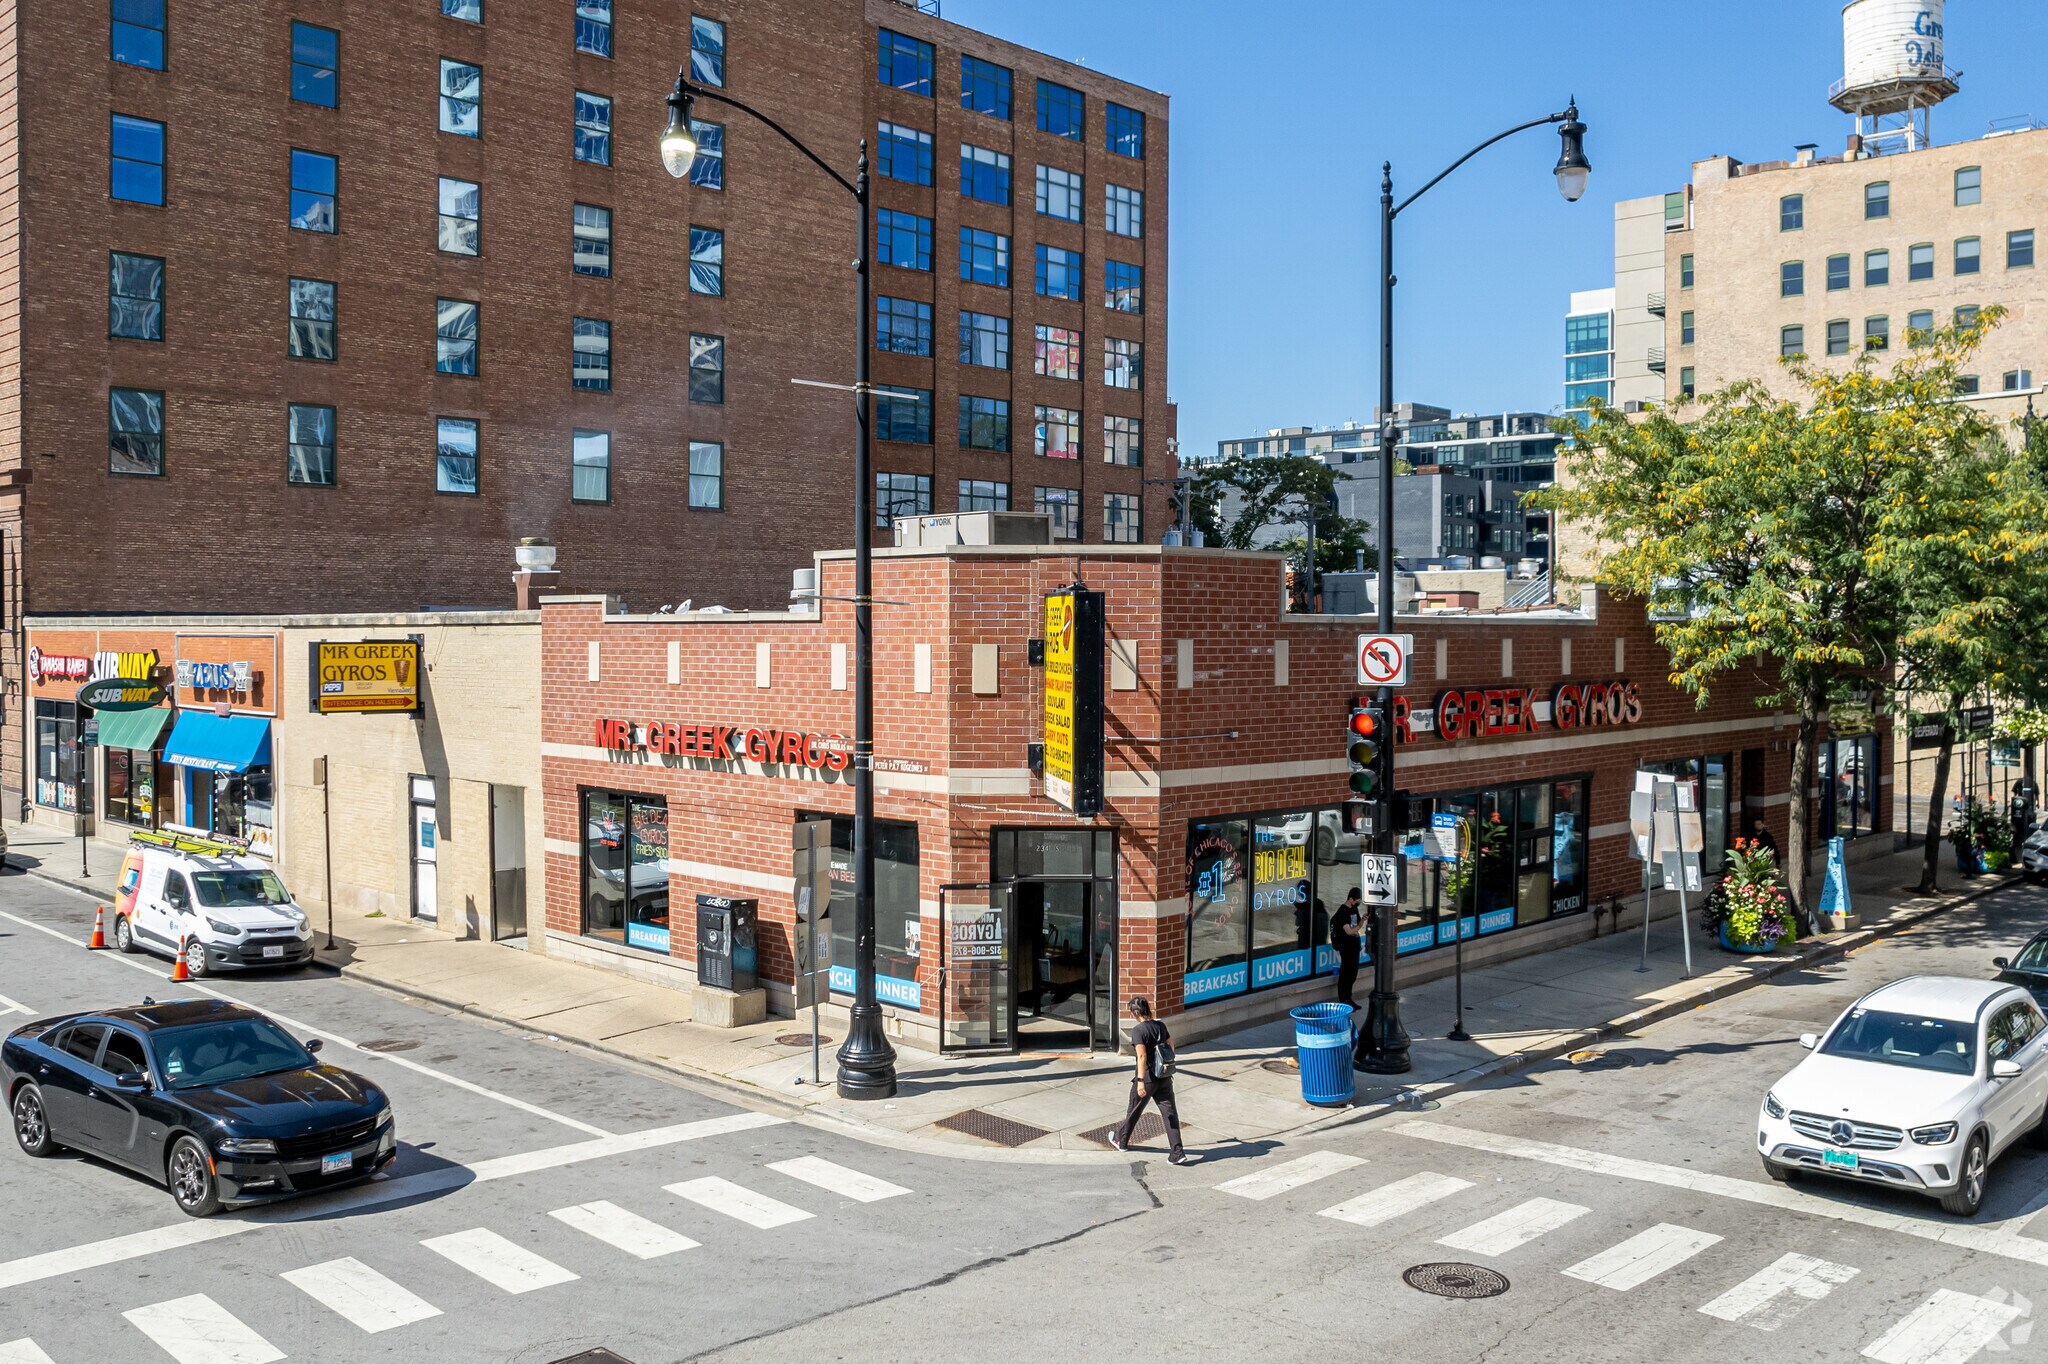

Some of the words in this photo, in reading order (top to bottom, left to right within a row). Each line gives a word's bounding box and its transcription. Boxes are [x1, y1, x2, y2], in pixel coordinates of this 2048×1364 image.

[935, 518, 951, 526] YORK
[323, 646, 349, 659] MR
[354, 645, 414, 659] GREEK
[66, 658, 88, 677] RAMEN
[89, 650, 155, 682] SUBWAY
[323, 664, 387, 681] GYROS
[192, 662, 231, 689] ZEUS
[89, 686, 159, 703] SUBWAY
[323, 683, 342, 692] PEPSI
[323, 699, 364, 707] ENTERANCE
[364, 698, 375, 706] ON
[375, 697, 404, 706] HALSTED
[1440, 688, 1540, 741] GREEK
[1556, 682, 1642, 730] GYROS
[595, 718, 638, 751] MR.
[646, 721, 734, 761] GREEK
[745, 727, 849, 771] GYROS
[181, 755, 218, 769] RESTAURANT
[633, 811, 649, 829] BIG
[639, 828, 668, 845] GYROS
[1254, 831, 1275, 843] THE
[1254, 850, 1275, 885] BIG
[1277, 845, 1307, 881] DEAL
[1367, 859, 1392, 871] ONE
[840, 870, 856, 883] BEE
[1367, 873, 1392, 885] WAY
[1253, 884, 1308, 911] GYROS
[1553, 895, 1581, 913] CHICKEN
[1481, 912, 1511, 930] DINNER
[630, 929, 670, 946] BREAKFAST
[1398, 931, 1433, 947] REAKFAST
[1258, 955, 1304, 982] LUNCH
[830, 970, 852, 988] NCH
[1184, 970, 1246, 996] BREAKFAST
[876, 980, 918, 1002] INNER
